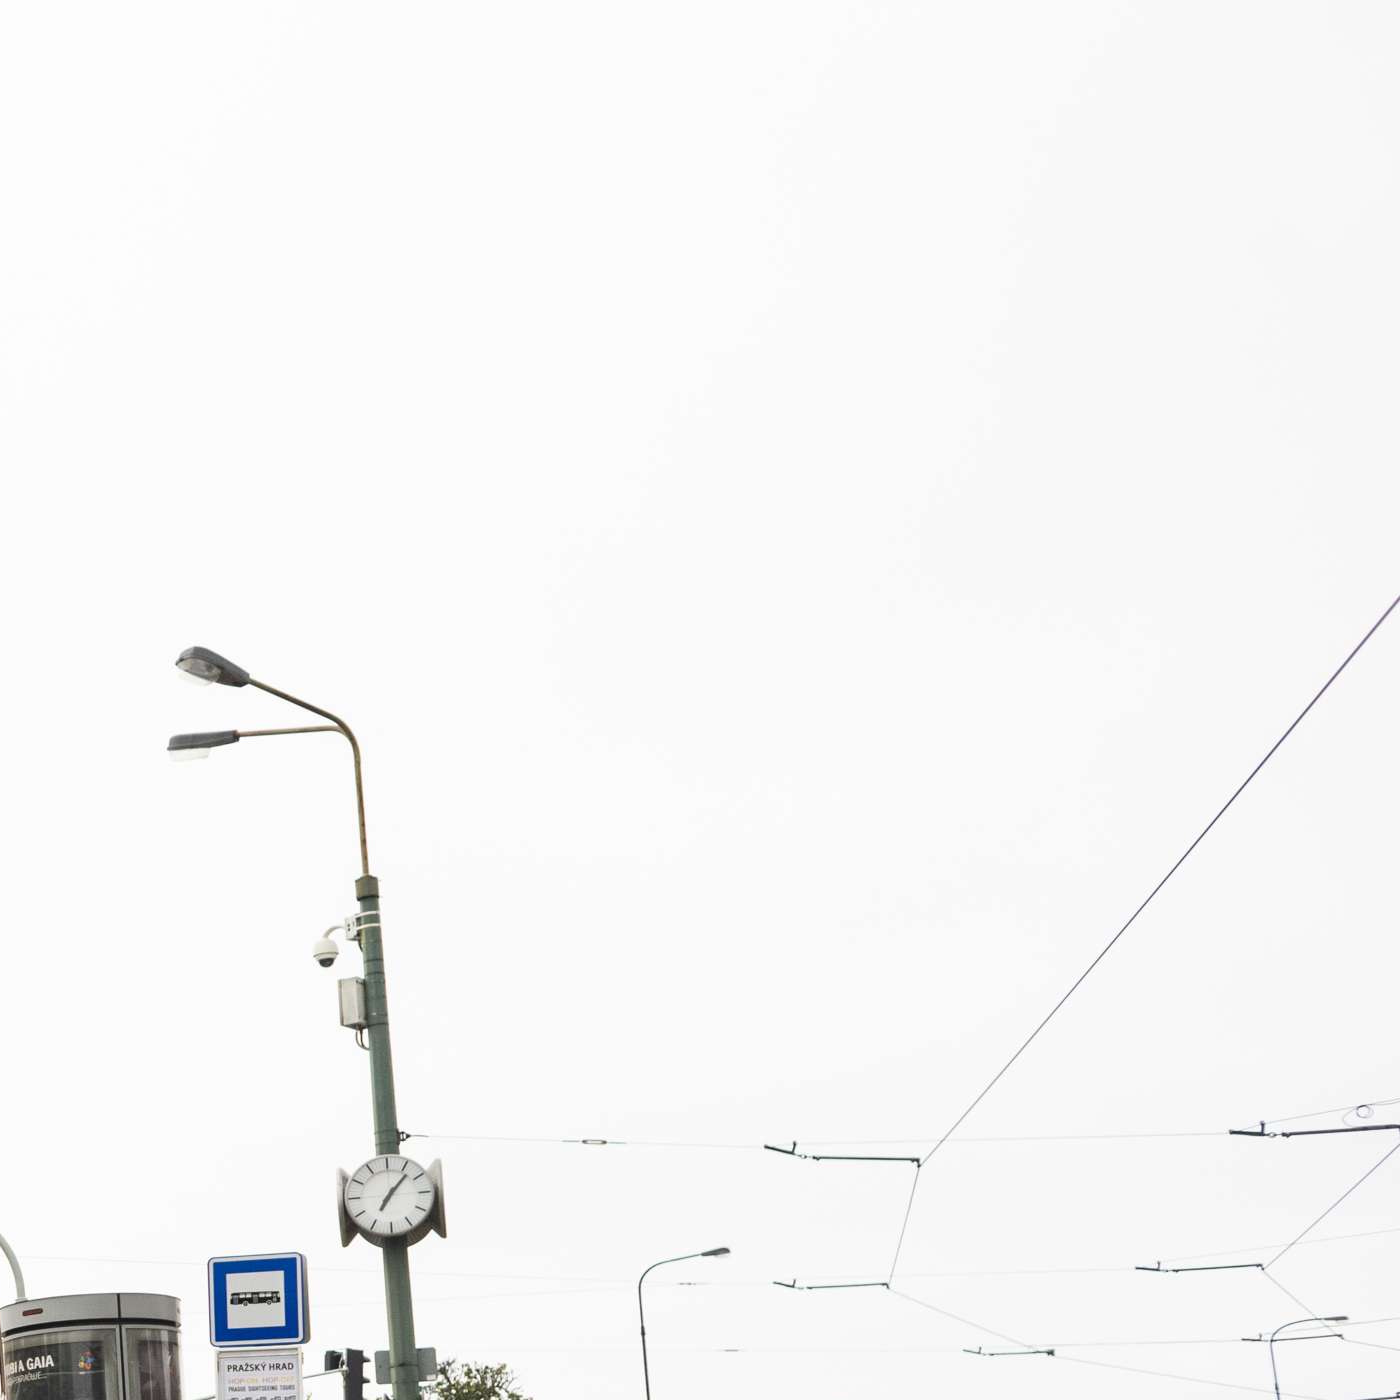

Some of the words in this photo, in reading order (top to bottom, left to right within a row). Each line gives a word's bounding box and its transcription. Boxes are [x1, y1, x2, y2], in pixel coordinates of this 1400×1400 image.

[26, 1354, 55, 1371] GAIA
[227, 1361, 267, 1372] PRAŽSKÝ
[268, 1362, 294, 1371] HRAD
